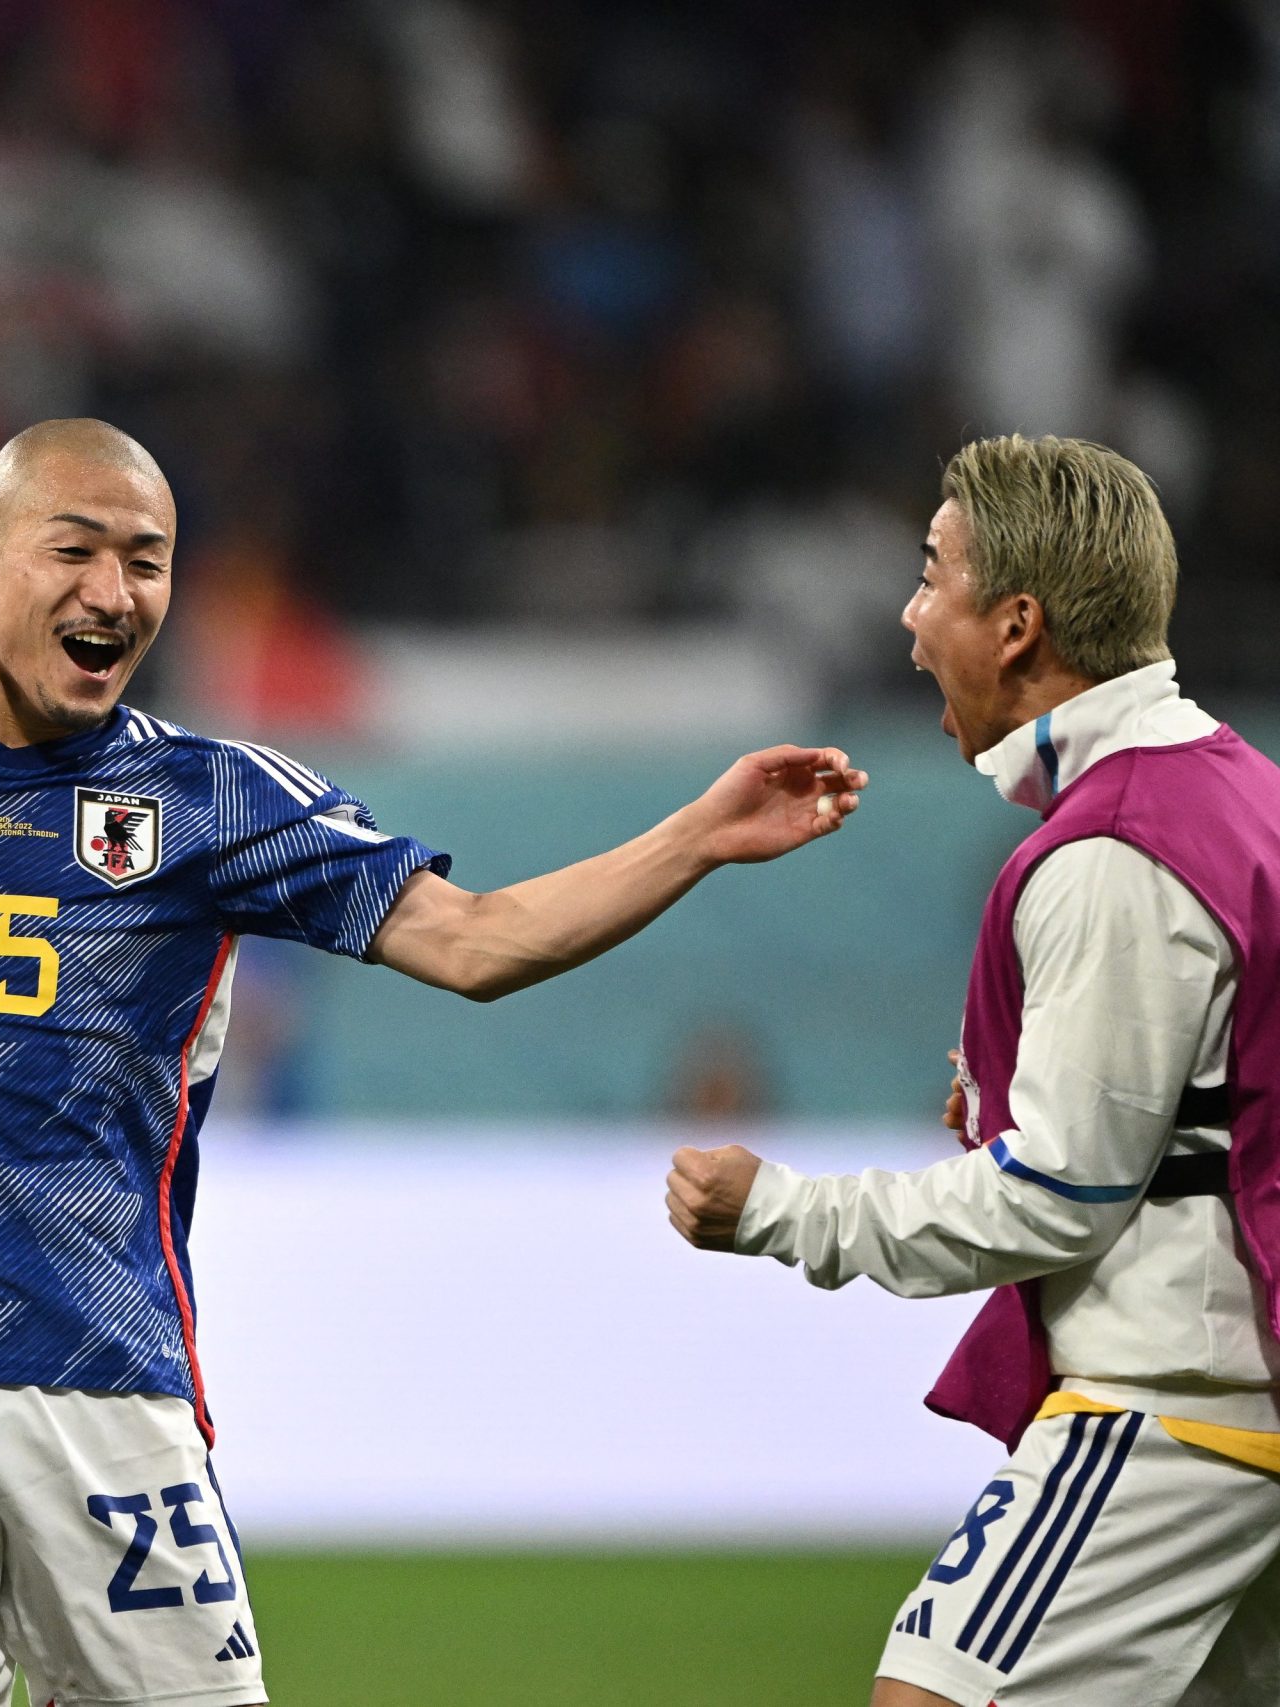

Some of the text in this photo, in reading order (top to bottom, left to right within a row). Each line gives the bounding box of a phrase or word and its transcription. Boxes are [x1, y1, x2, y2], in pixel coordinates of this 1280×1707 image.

[97, 793, 140, 806] JAPAN
[14, 822, 33, 830] 2022
[27, 829, 59, 838] STADIUM
[98, 853, 136, 870] JFA
[927, 1479, 1016, 1585] 8
[86, 1482, 237, 1614] 25
